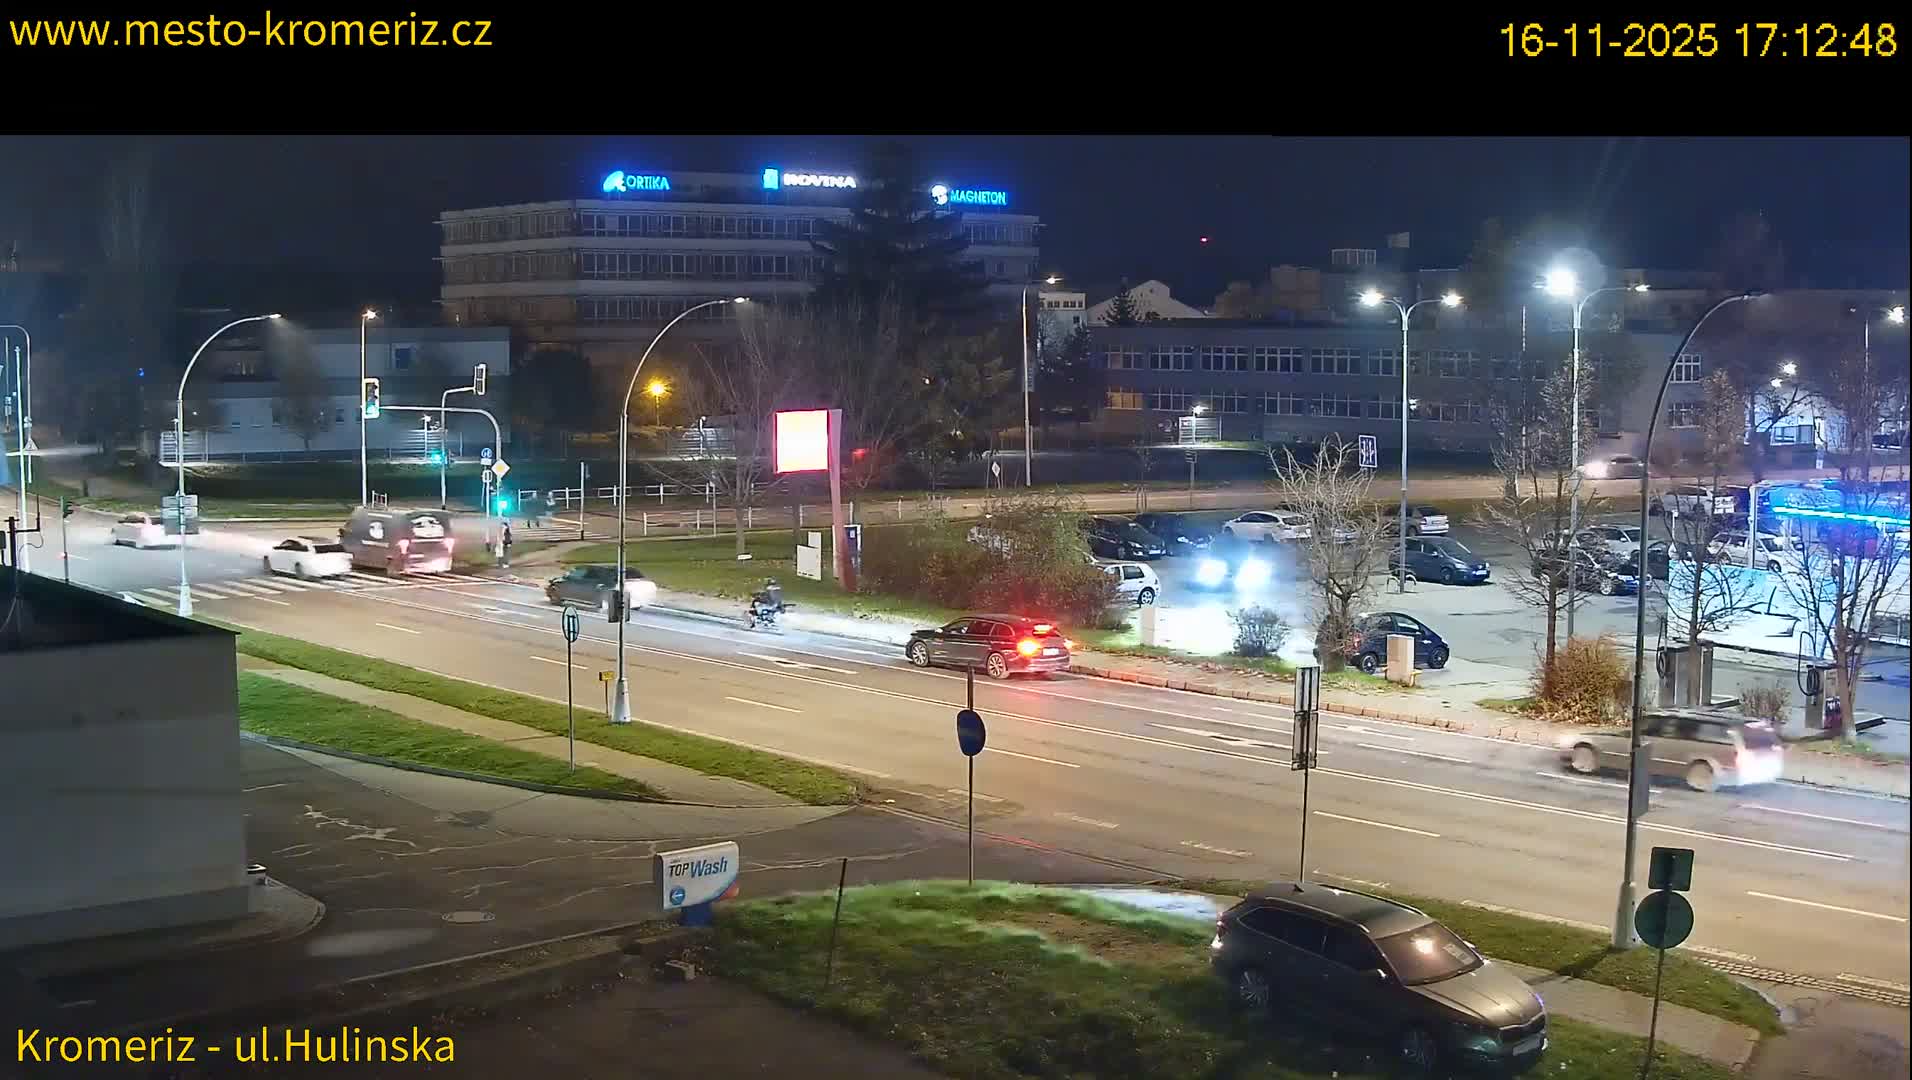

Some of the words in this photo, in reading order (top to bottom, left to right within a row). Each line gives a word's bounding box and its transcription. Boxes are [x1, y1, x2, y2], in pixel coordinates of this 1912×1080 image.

[626, 174, 671, 190] ORTIKA
[950, 189, 1007, 206] MAGNETON
[668, 861, 690, 878] TOP
[690, 856, 728, 878] Wash
